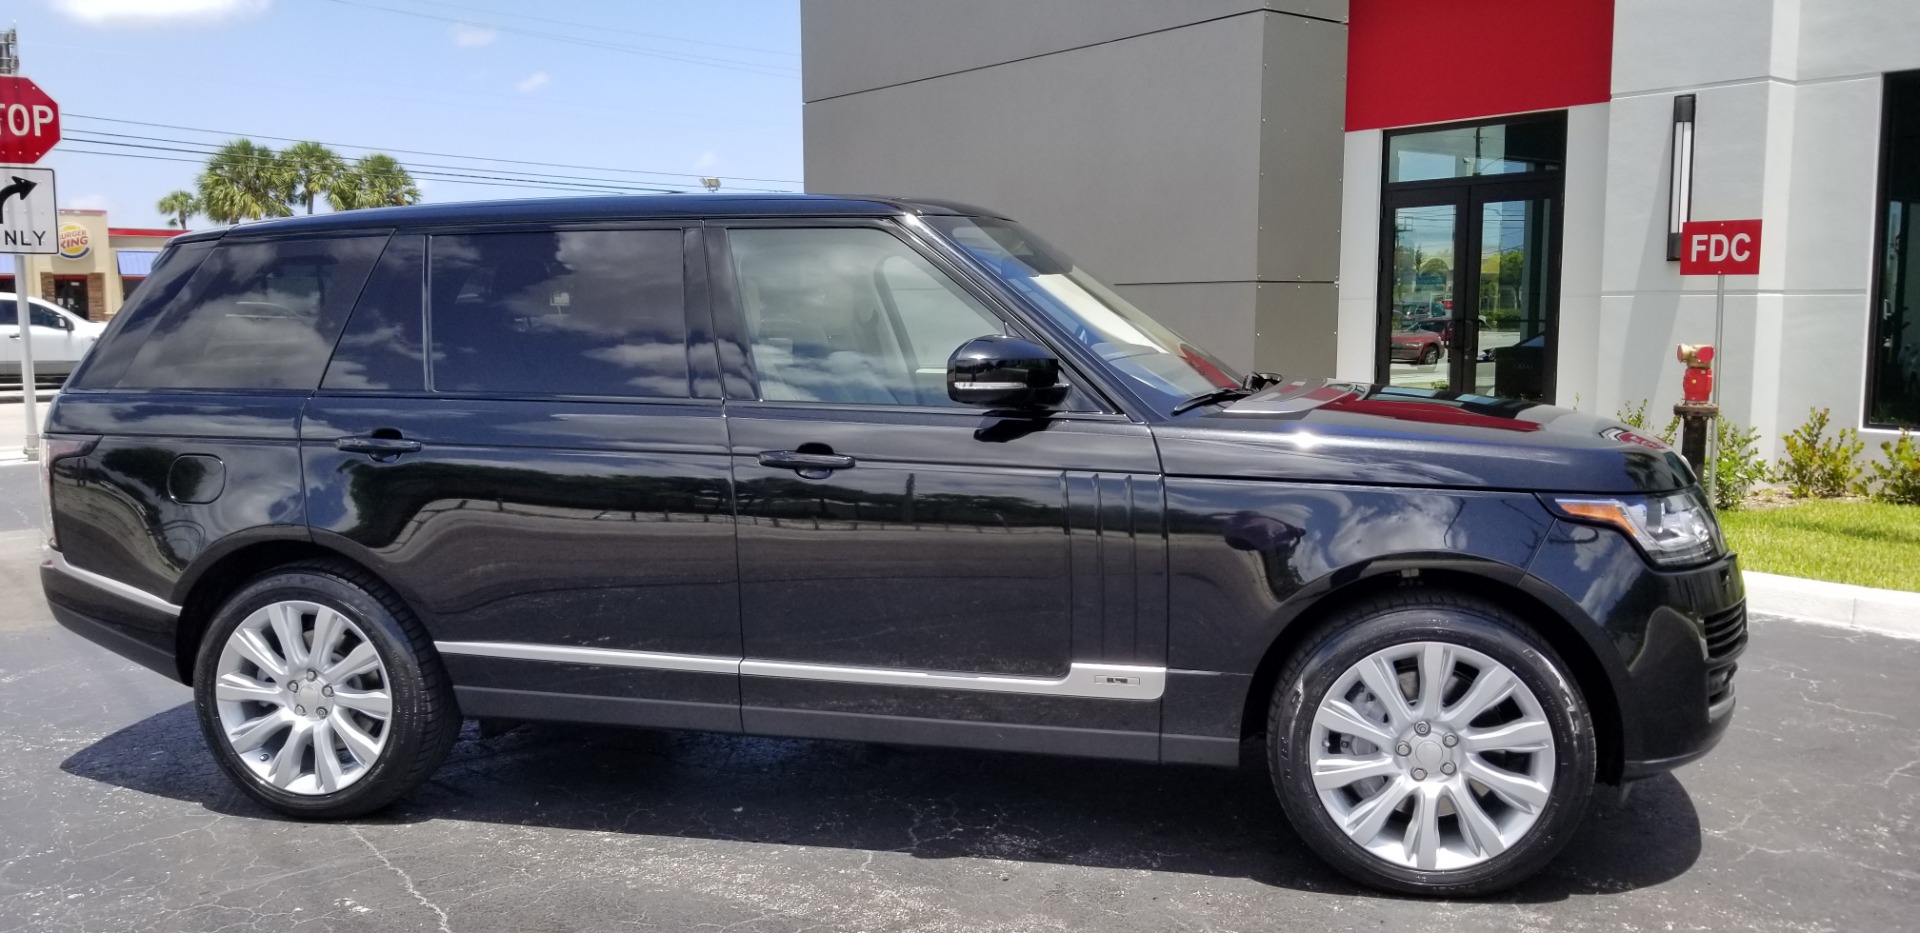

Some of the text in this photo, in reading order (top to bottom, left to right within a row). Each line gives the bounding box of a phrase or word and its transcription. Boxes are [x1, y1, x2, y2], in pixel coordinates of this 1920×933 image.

[4, 229, 47, 246] NLY
[60, 229, 87, 240] URGER
[1691, 232, 1751, 262] FDC
